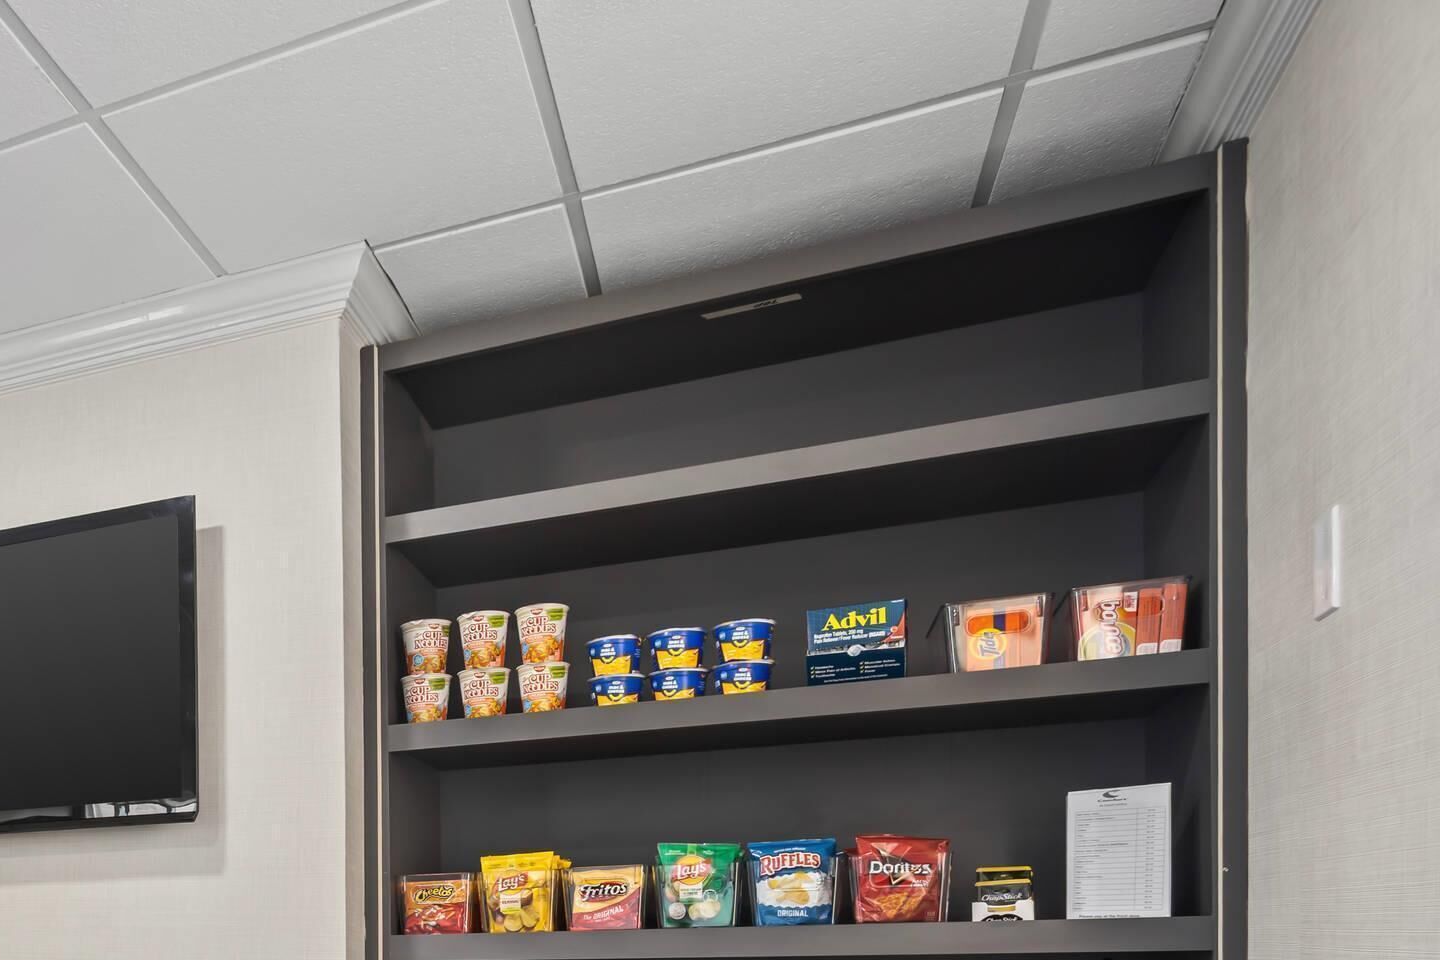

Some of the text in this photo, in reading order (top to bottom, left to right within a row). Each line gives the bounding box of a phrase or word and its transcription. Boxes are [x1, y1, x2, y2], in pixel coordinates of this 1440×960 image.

[527, 616, 548, 627] CUP
[821, 607, 886, 631] Advil
[468, 623, 489, 633] CUP
[469, 679, 490, 690] CUP
[529, 673, 551, 684] CUP
[410, 685, 431, 696] CUP
[677, 862, 706, 880] Lay's
[760, 852, 821, 876] RUFFLES
[869, 861, 931, 875] Doritos
[498, 874, 525, 892] Lay's
[415, 885, 454, 902] Cheetos
[580, 883, 627, 902] Fritos
[593, 905, 624, 920] ORIGINAL
[777, 909, 808, 917] ORIGINAL
